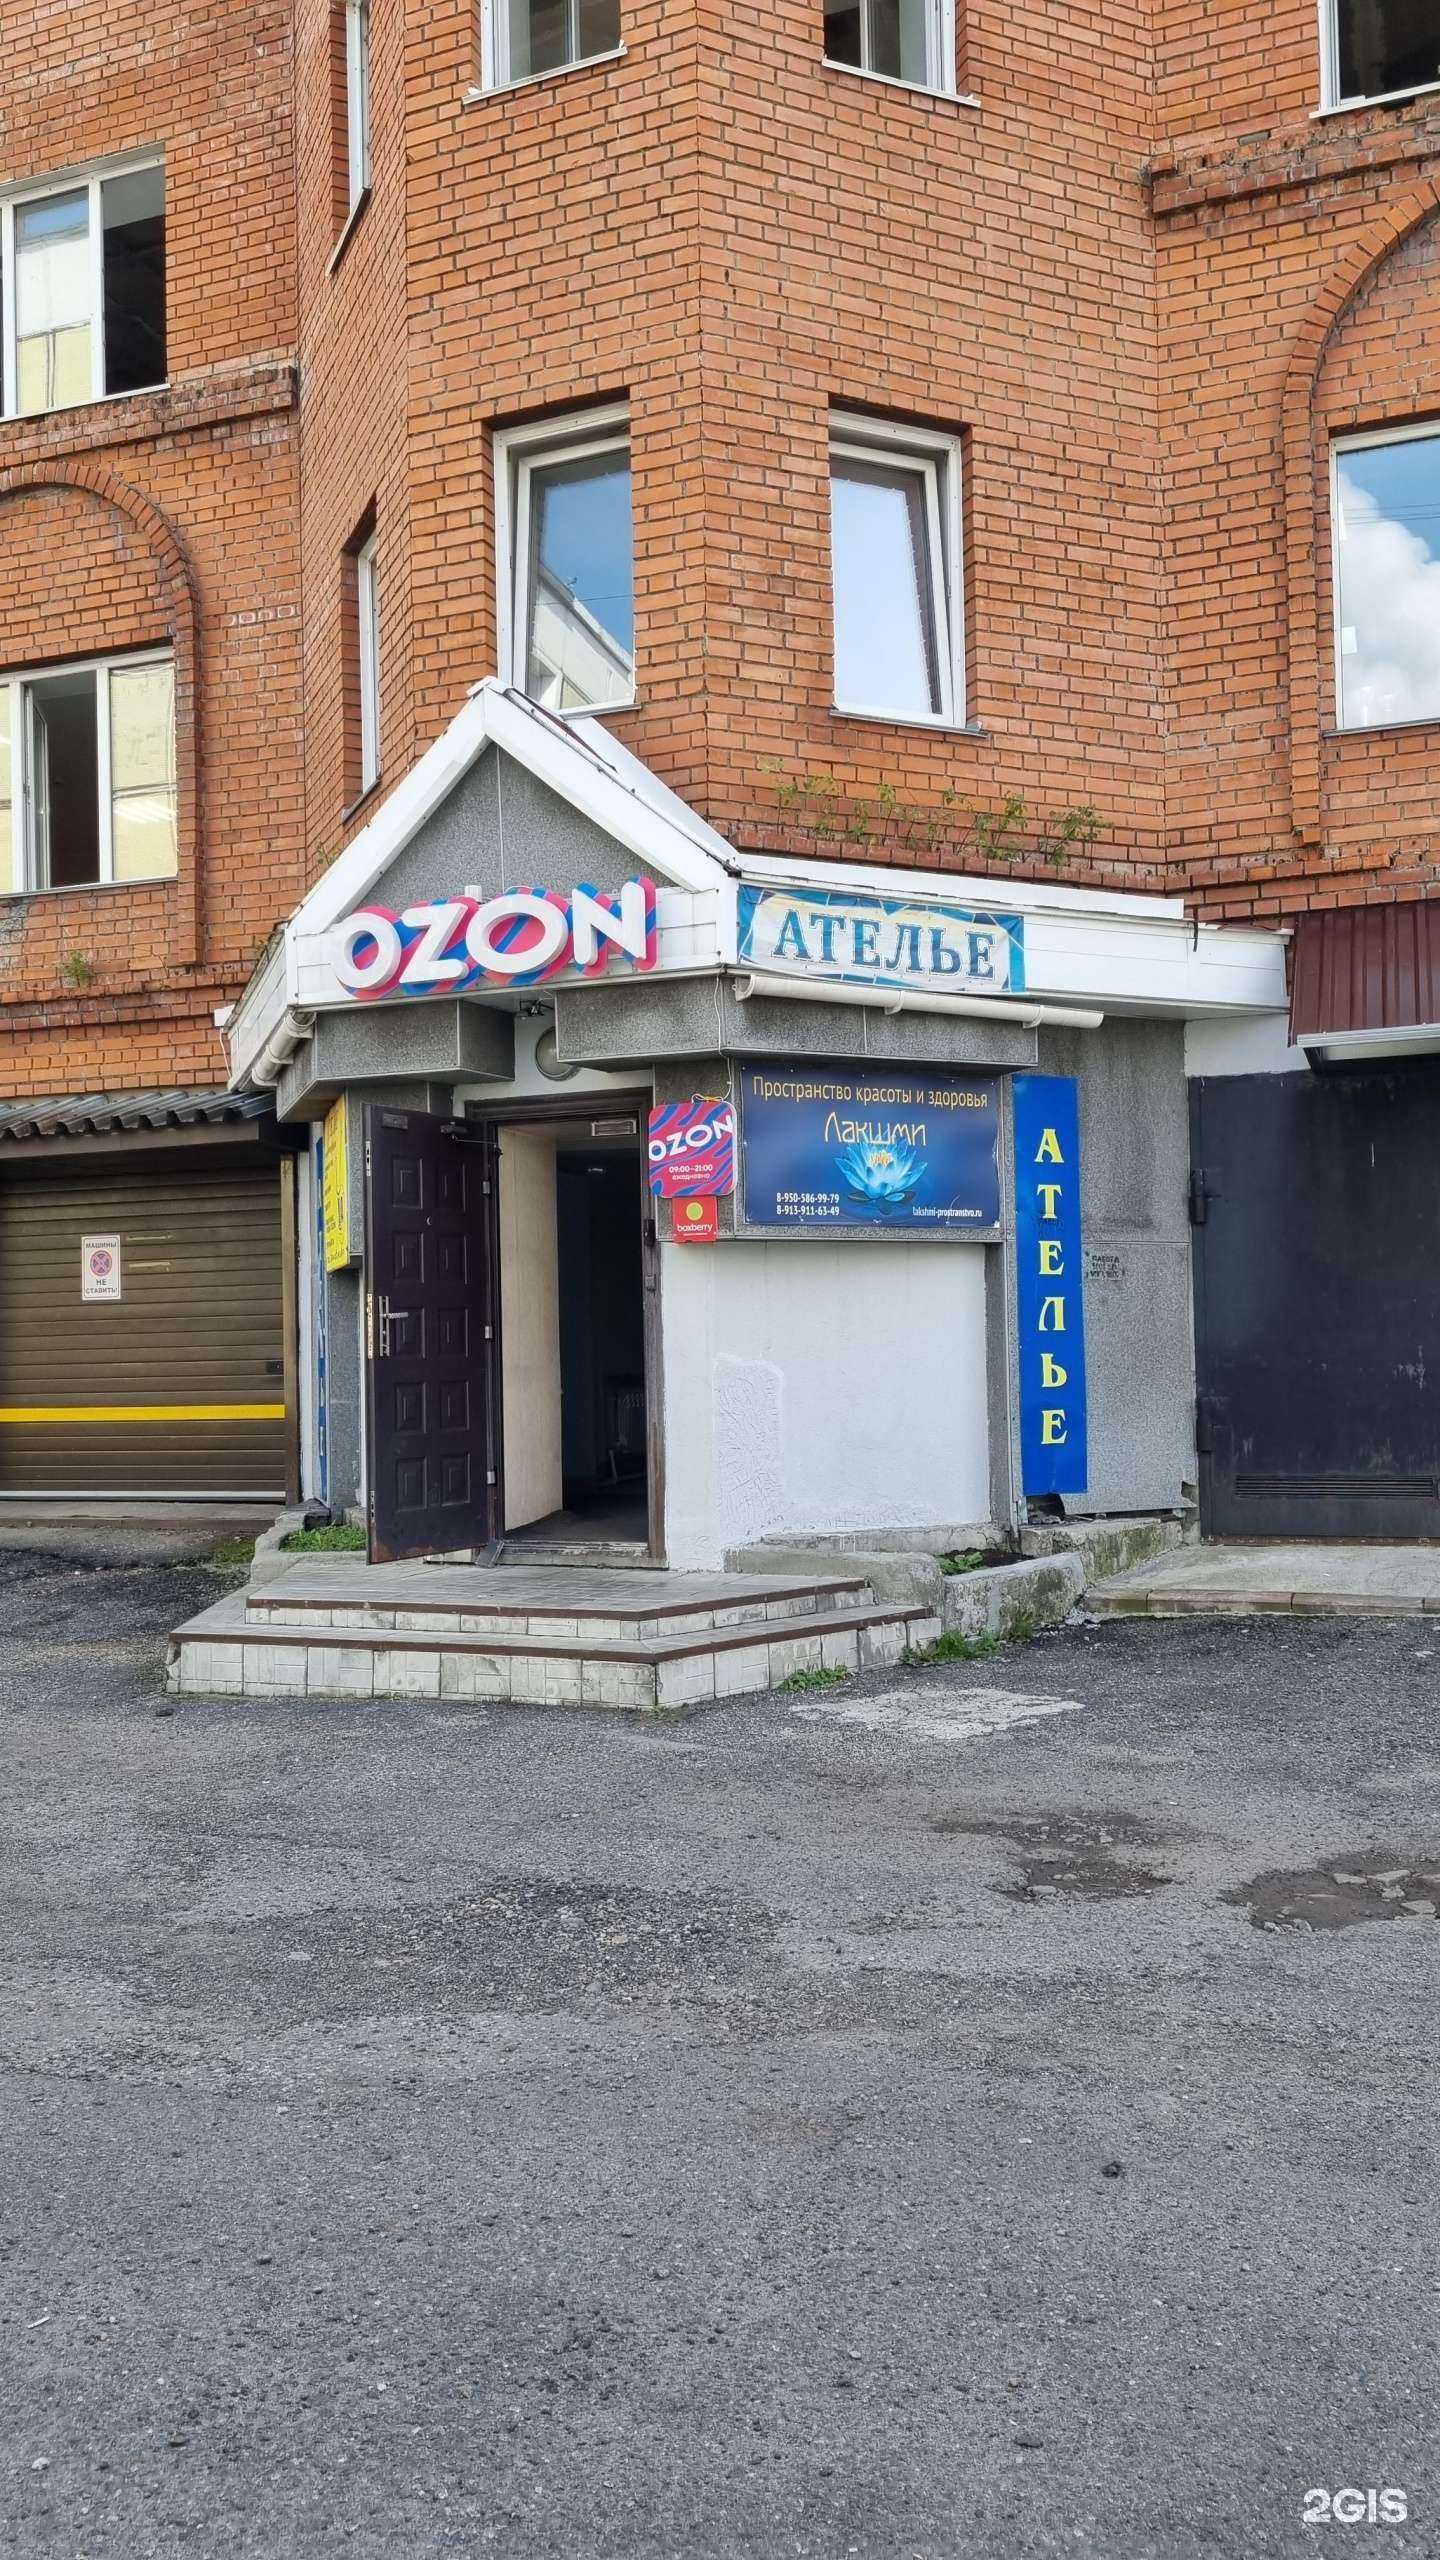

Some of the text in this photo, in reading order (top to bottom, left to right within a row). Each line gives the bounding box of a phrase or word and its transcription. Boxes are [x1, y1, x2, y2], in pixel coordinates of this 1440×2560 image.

[331, 880, 650, 990] OZON
[771, 908, 995, 980] АТЕЛЬЕ
[753, 1076, 988, 1110] Пространство красоты и здоровья
[649, 1114, 733, 1161] OZON
[824, 1112, 927, 1146] Лакшми
[776, 1192, 840, 1204] 8-950-586-99-79
[776, 1205, 840, 1216] 8-913-911-63-49
[677, 1224, 713, 1233] boxberry
[1034, 1128, 1068, 1445] АТЕЛЬЕ
